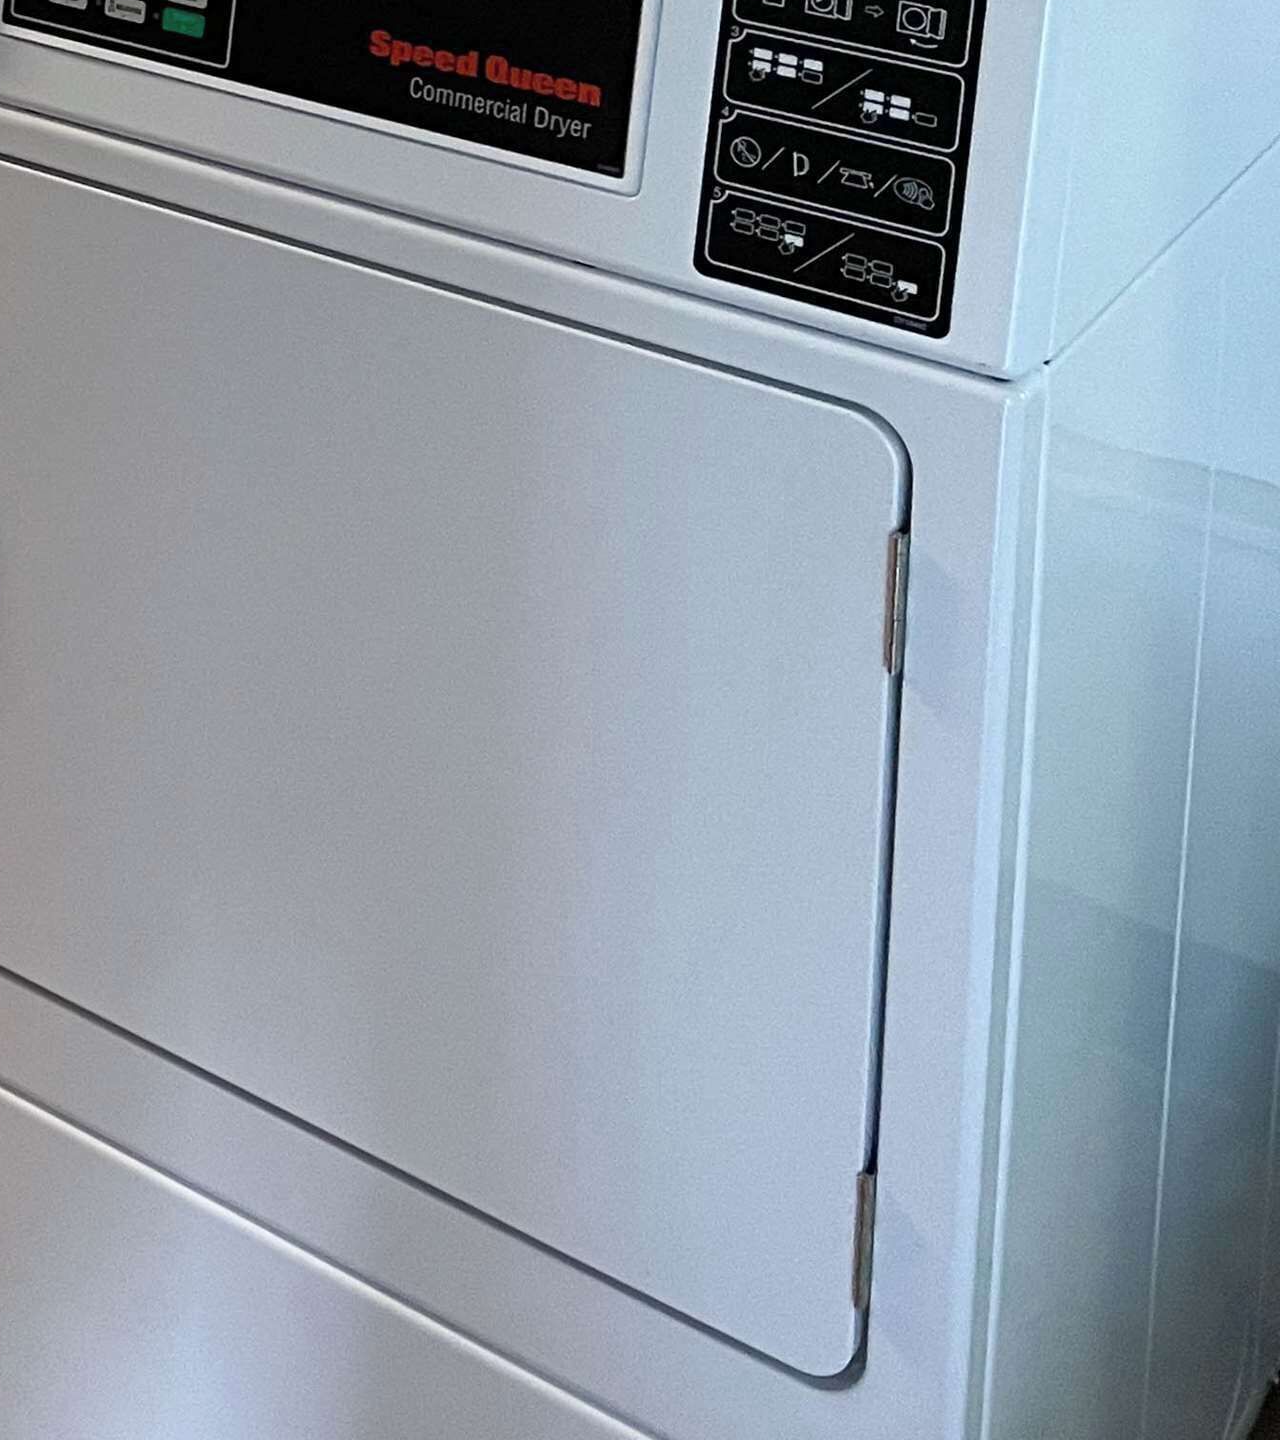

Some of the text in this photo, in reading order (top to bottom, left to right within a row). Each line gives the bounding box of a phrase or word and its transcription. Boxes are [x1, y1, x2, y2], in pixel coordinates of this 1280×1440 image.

[731, 25, 739, 37] 3
[369, 29, 602, 108] Speed Queen
[409, 76, 592, 140] Commercial Dryer
[713, 186, 721, 198] 5
